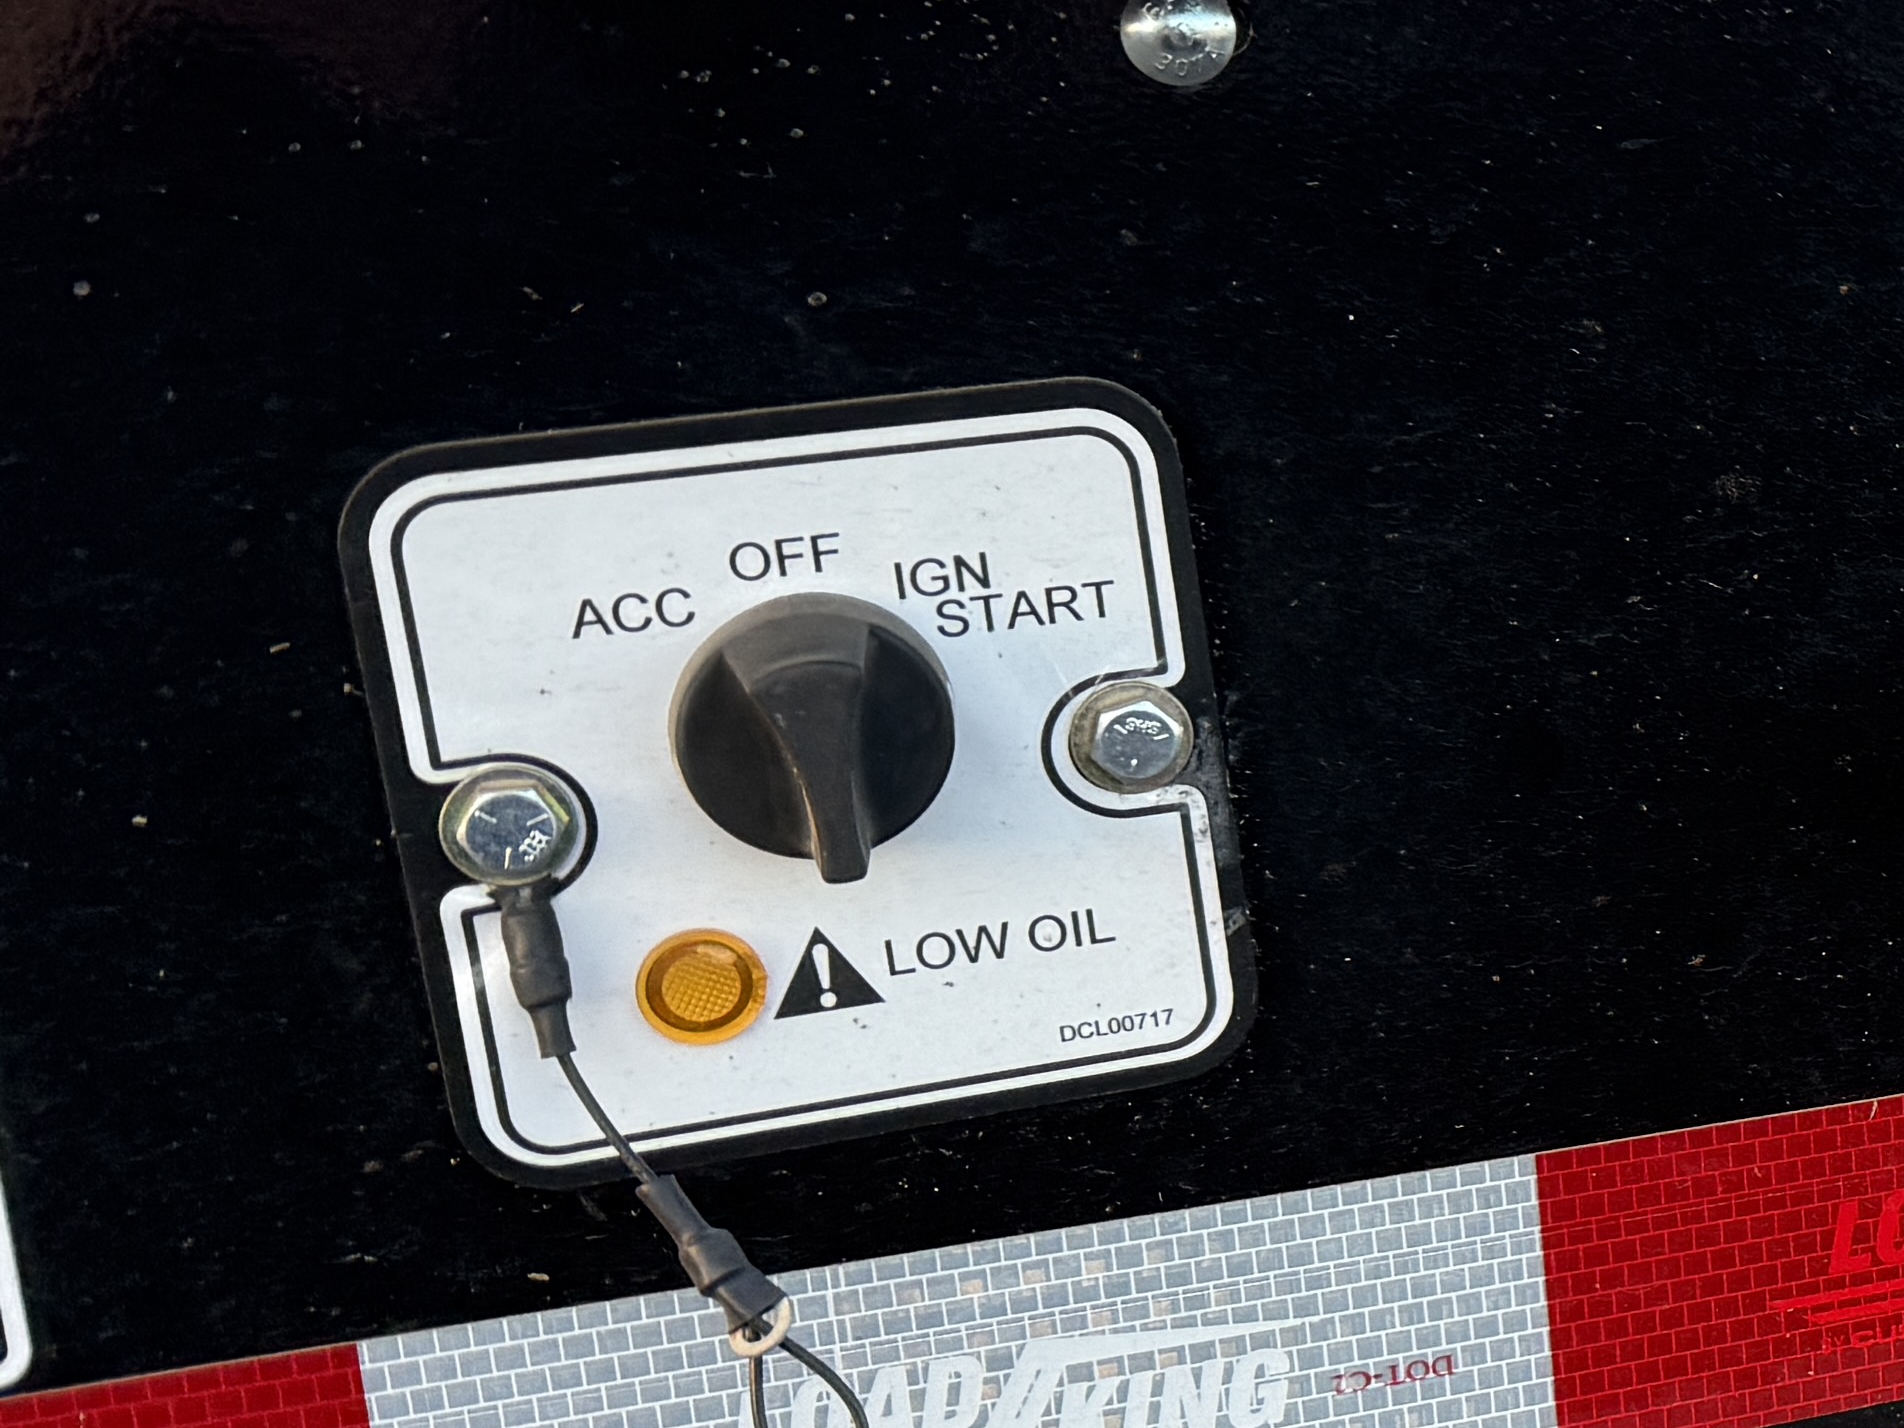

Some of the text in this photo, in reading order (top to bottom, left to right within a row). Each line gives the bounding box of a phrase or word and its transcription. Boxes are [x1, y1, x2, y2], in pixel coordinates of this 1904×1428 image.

[728, 533, 841, 582] OFF
[893, 552, 991, 600] IGN
[571, 588, 697, 640] ACC
[936, 581, 1115, 638] START
[885, 908, 1116, 976] LOW OIL
[1060, 1009, 1175, 1044] DCL00717
